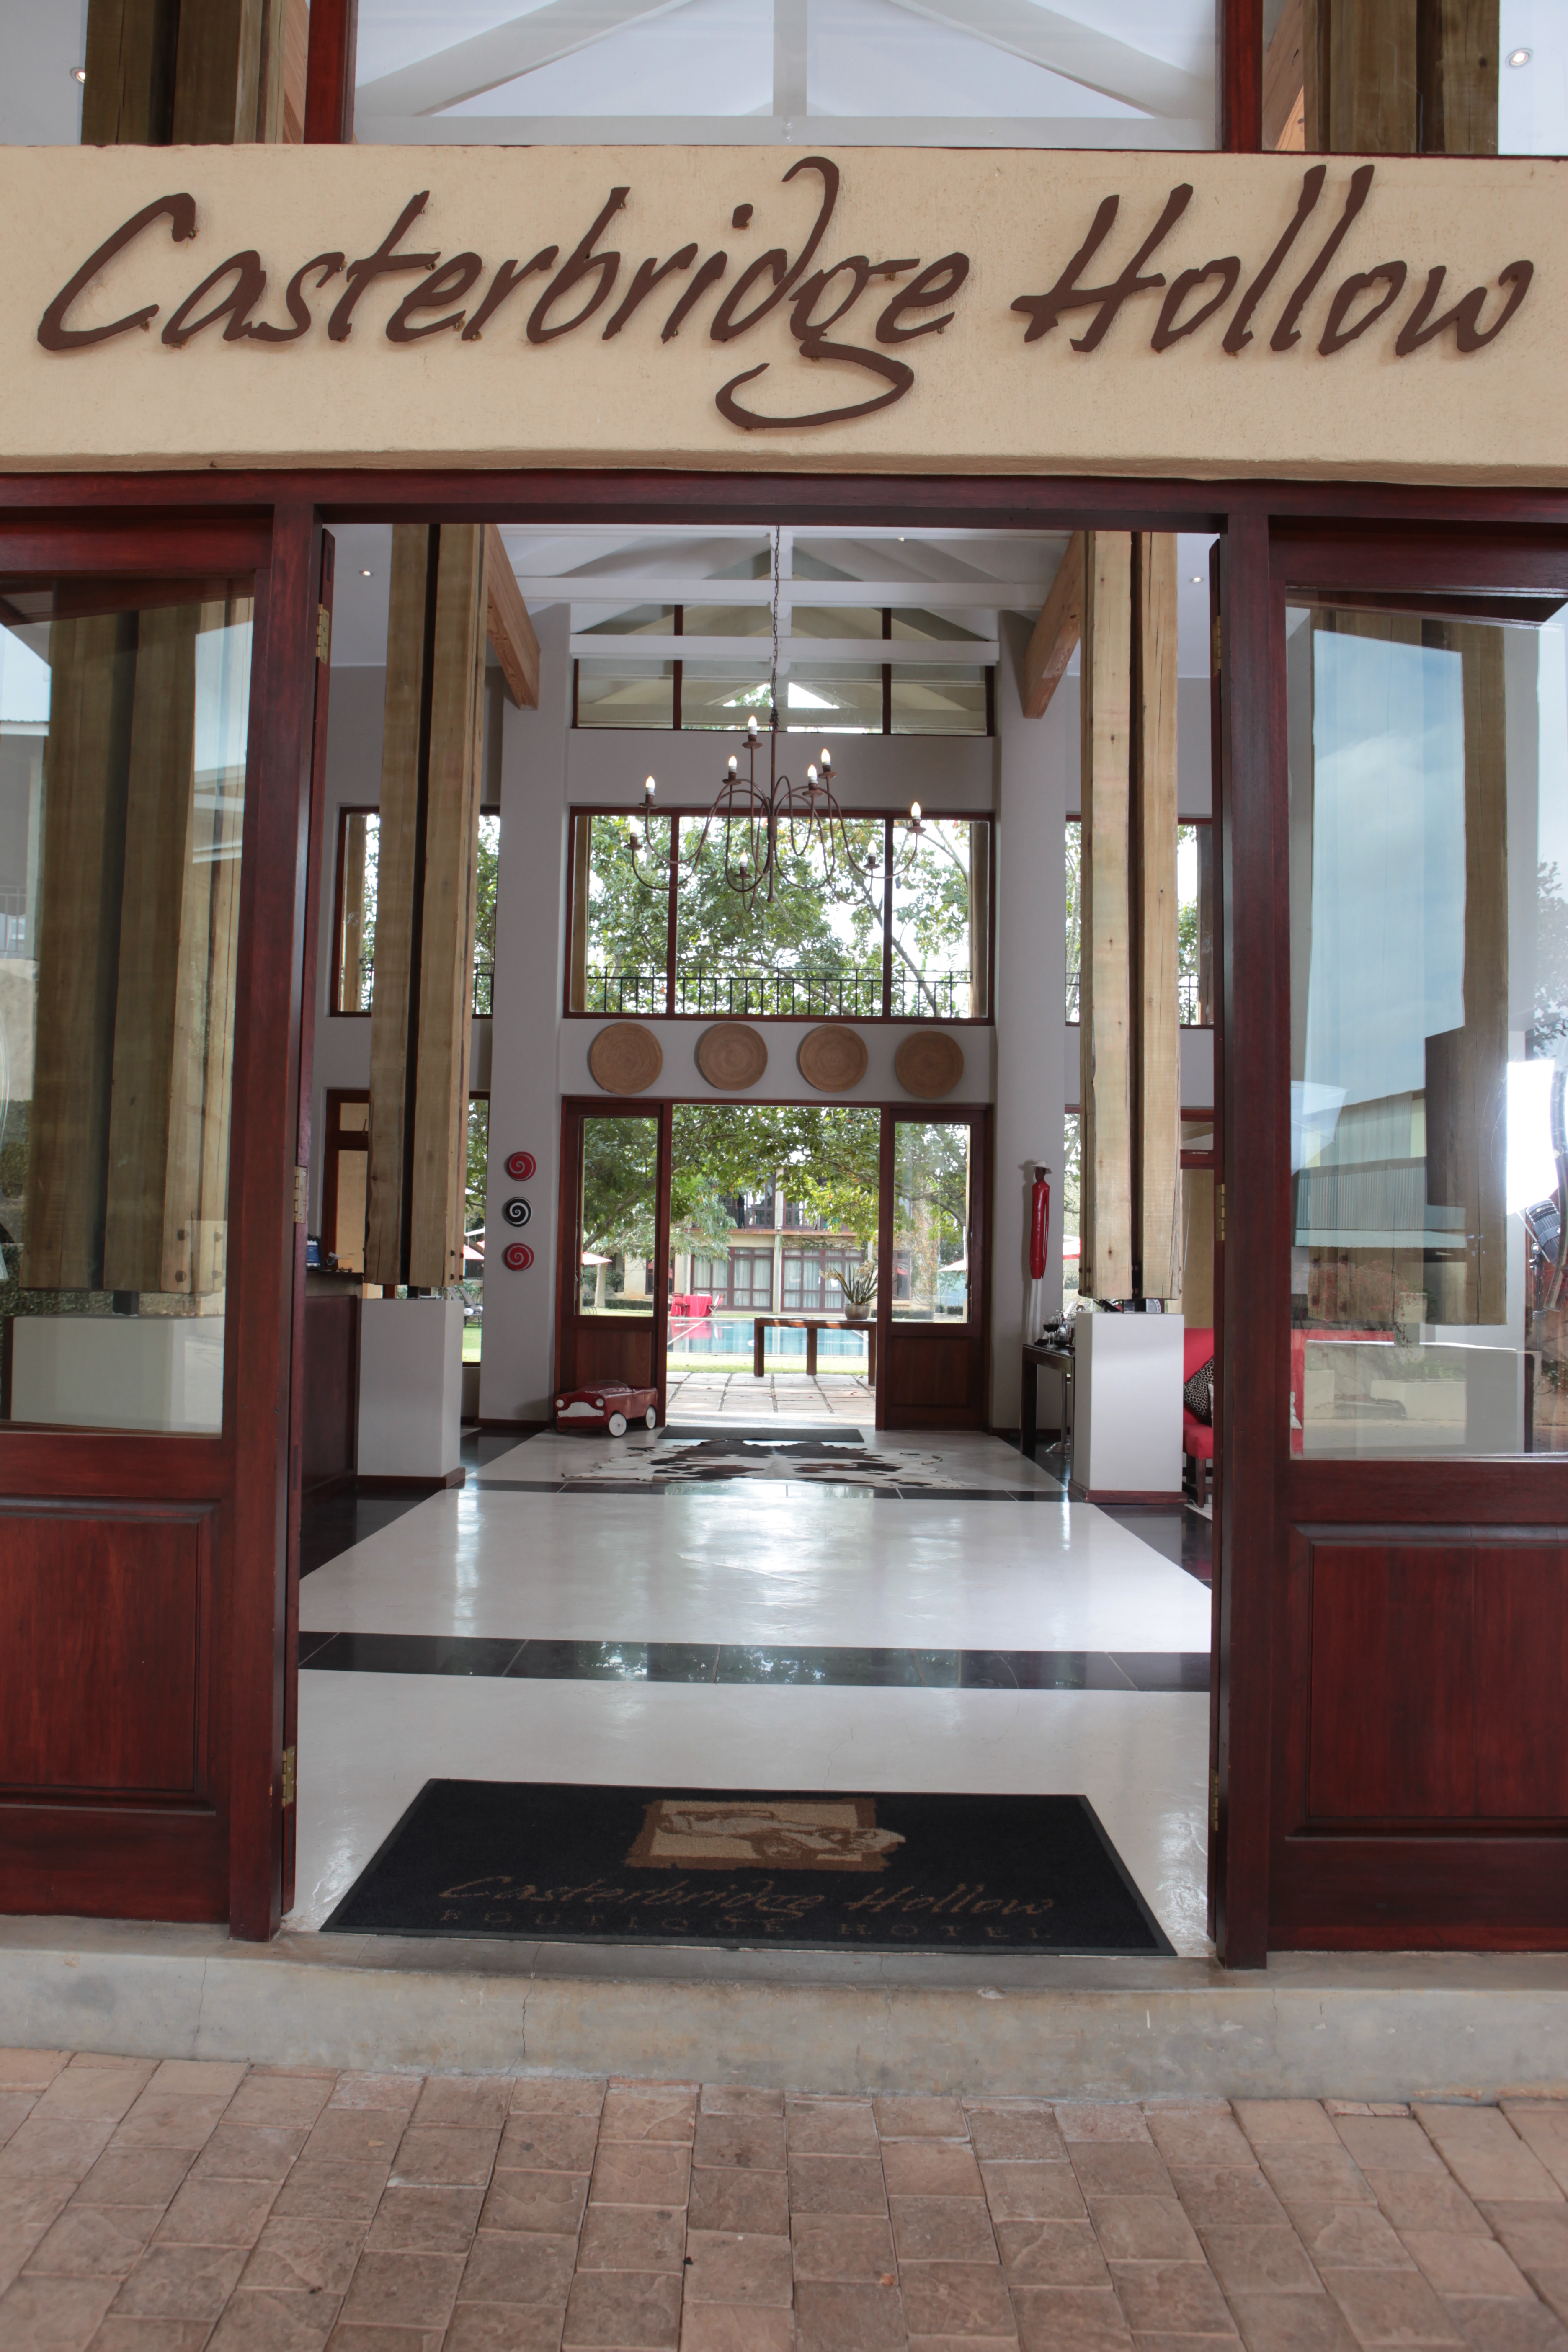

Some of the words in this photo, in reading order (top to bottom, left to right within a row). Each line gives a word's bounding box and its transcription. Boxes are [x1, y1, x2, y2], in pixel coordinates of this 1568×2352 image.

[36, 156, 970, 431] Casterbridge
[1010, 164, 1534, 357] Hollow
[438, 1875, 825, 1923] Casterbridge
[843, 1883, 1055, 1915] Hollow
[841, 1923, 1051, 1939] HOTEL
